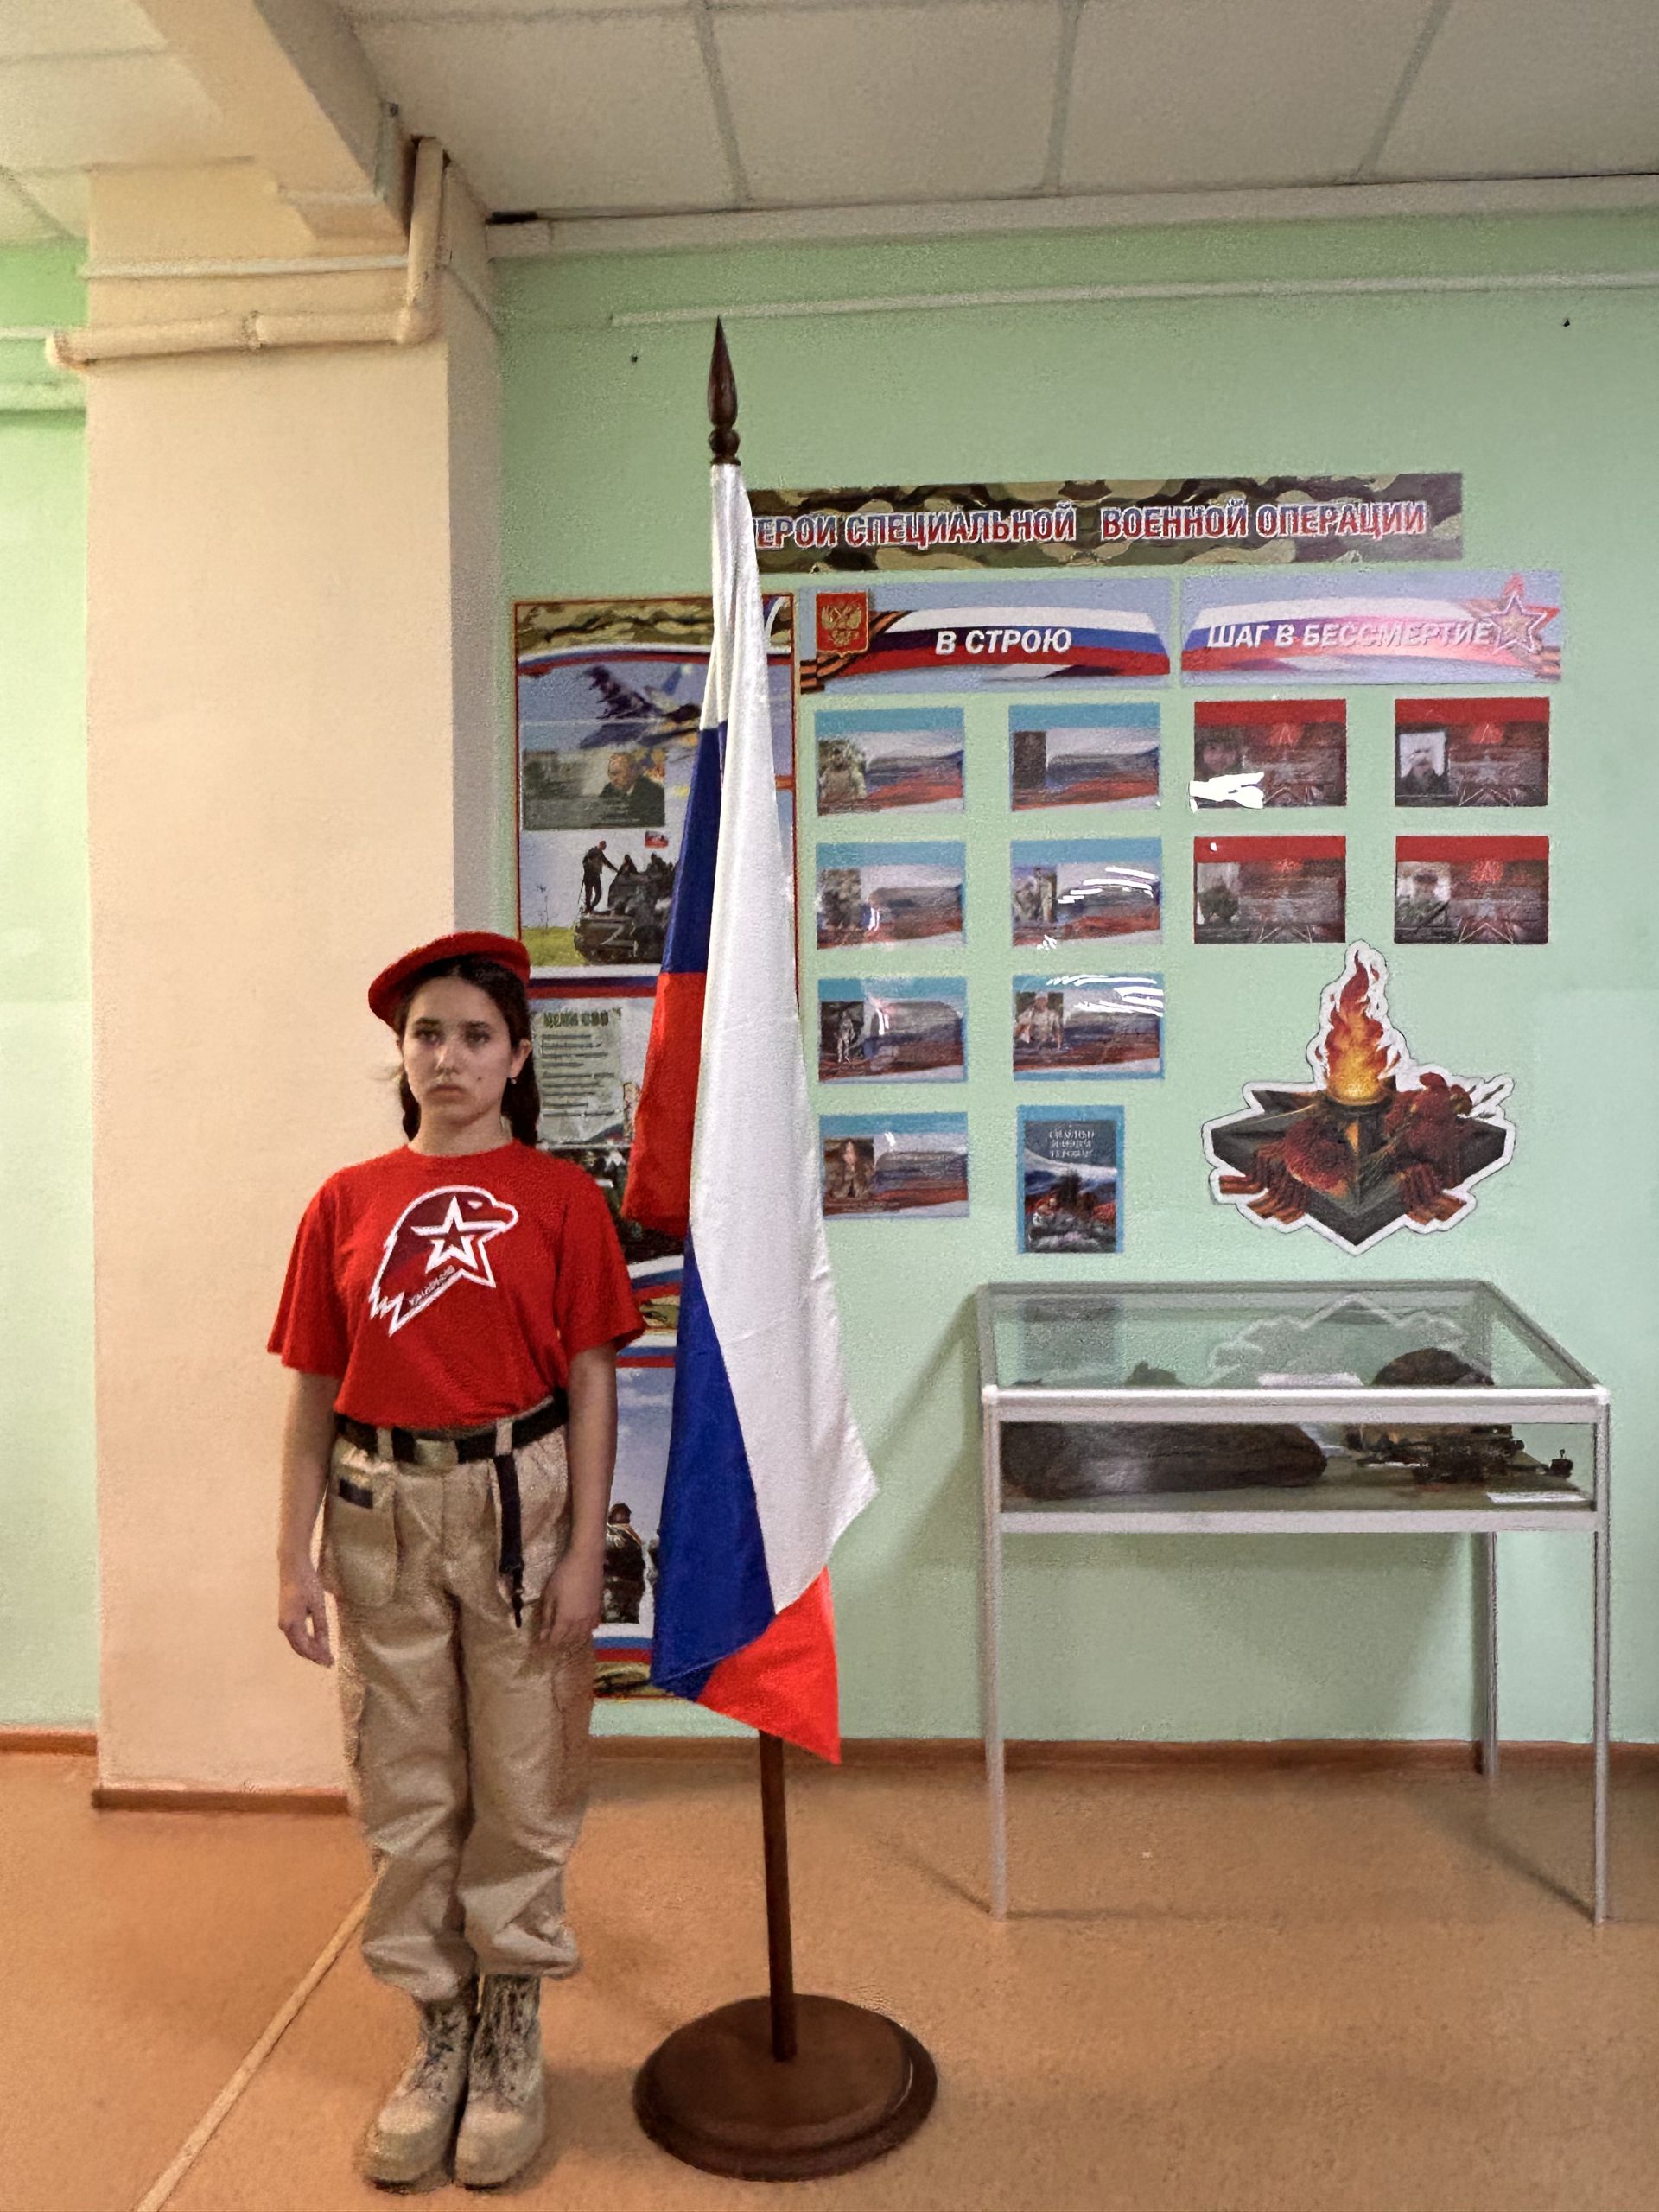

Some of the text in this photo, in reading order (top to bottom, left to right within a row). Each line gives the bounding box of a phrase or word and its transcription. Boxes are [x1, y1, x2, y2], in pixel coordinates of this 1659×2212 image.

[752, 498, 1428, 550] ЕРОИ СПЕЦИАЛЬНОЙ ВОЕННОЙ ОПЕРАЦИИ
[936, 628, 1073, 654] В СТРОЮ
[1207, 620, 1494, 649] ШАГ В БЕССМЕРТИЕ
